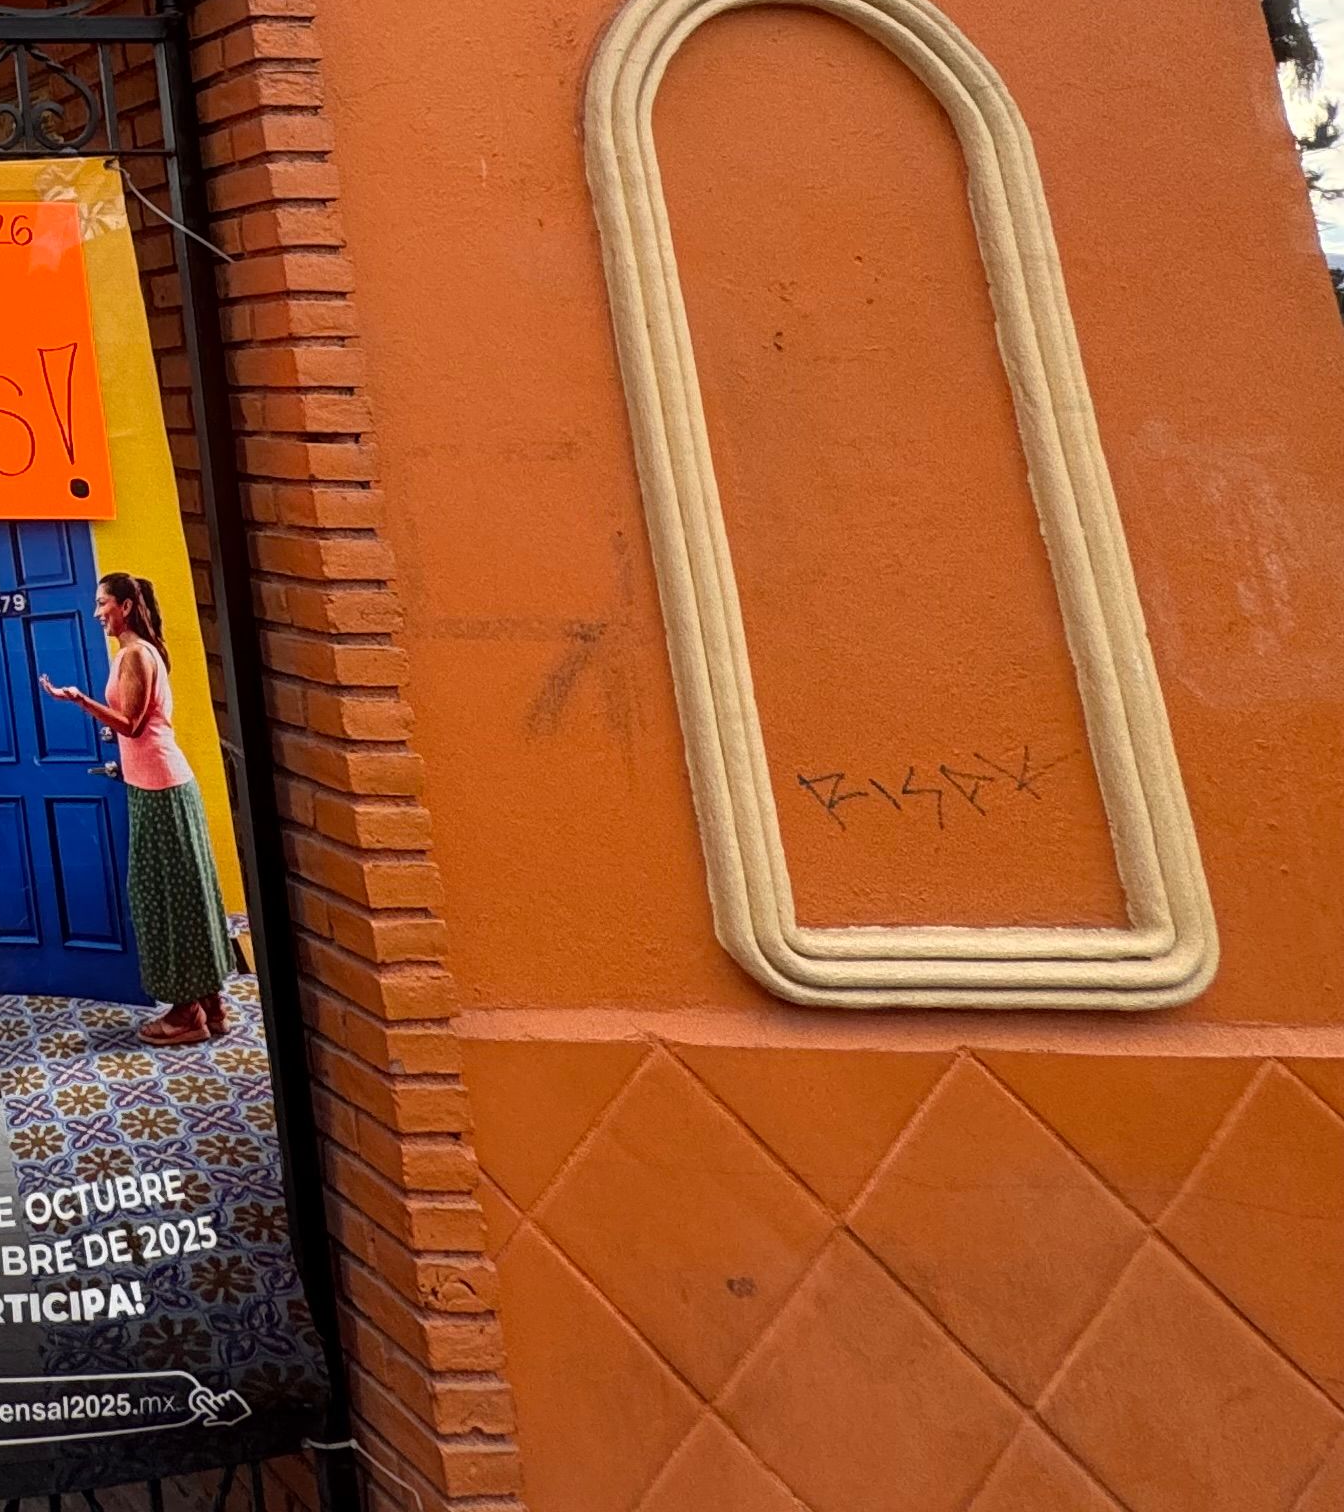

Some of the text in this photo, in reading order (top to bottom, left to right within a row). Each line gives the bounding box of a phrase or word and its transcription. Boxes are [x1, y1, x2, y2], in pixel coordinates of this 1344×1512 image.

[23, 1168, 187, 1227] OCTUBRE
[82, 1229, 129, 1266] DE
[141, 1215, 219, 1261] 2025
